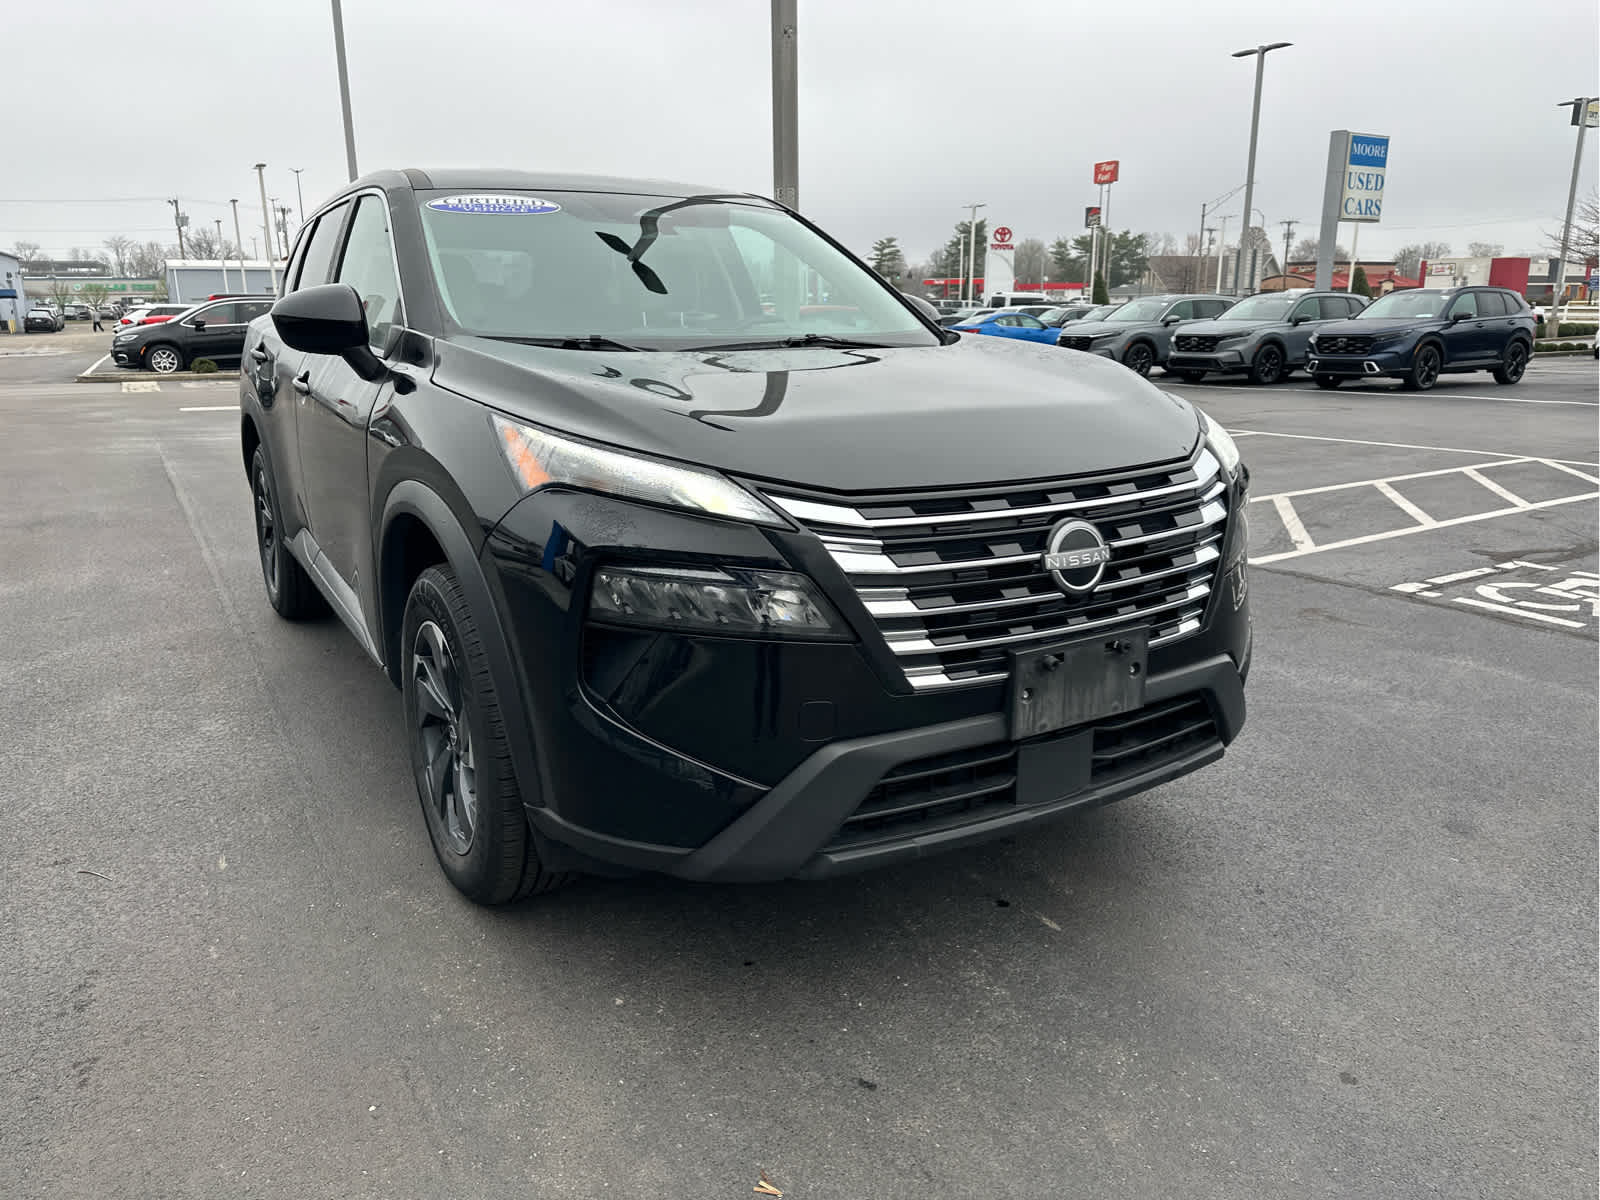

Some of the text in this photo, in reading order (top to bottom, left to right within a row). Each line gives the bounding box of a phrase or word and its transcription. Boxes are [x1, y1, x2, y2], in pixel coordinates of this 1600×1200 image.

[1352, 142, 1386, 157] MOORE
[1347, 171, 1384, 191] USED
[443, 198, 545, 206] CERTIFIED
[1344, 197, 1382, 216] CARS
[1047, 550, 1110, 568] NISSAN
